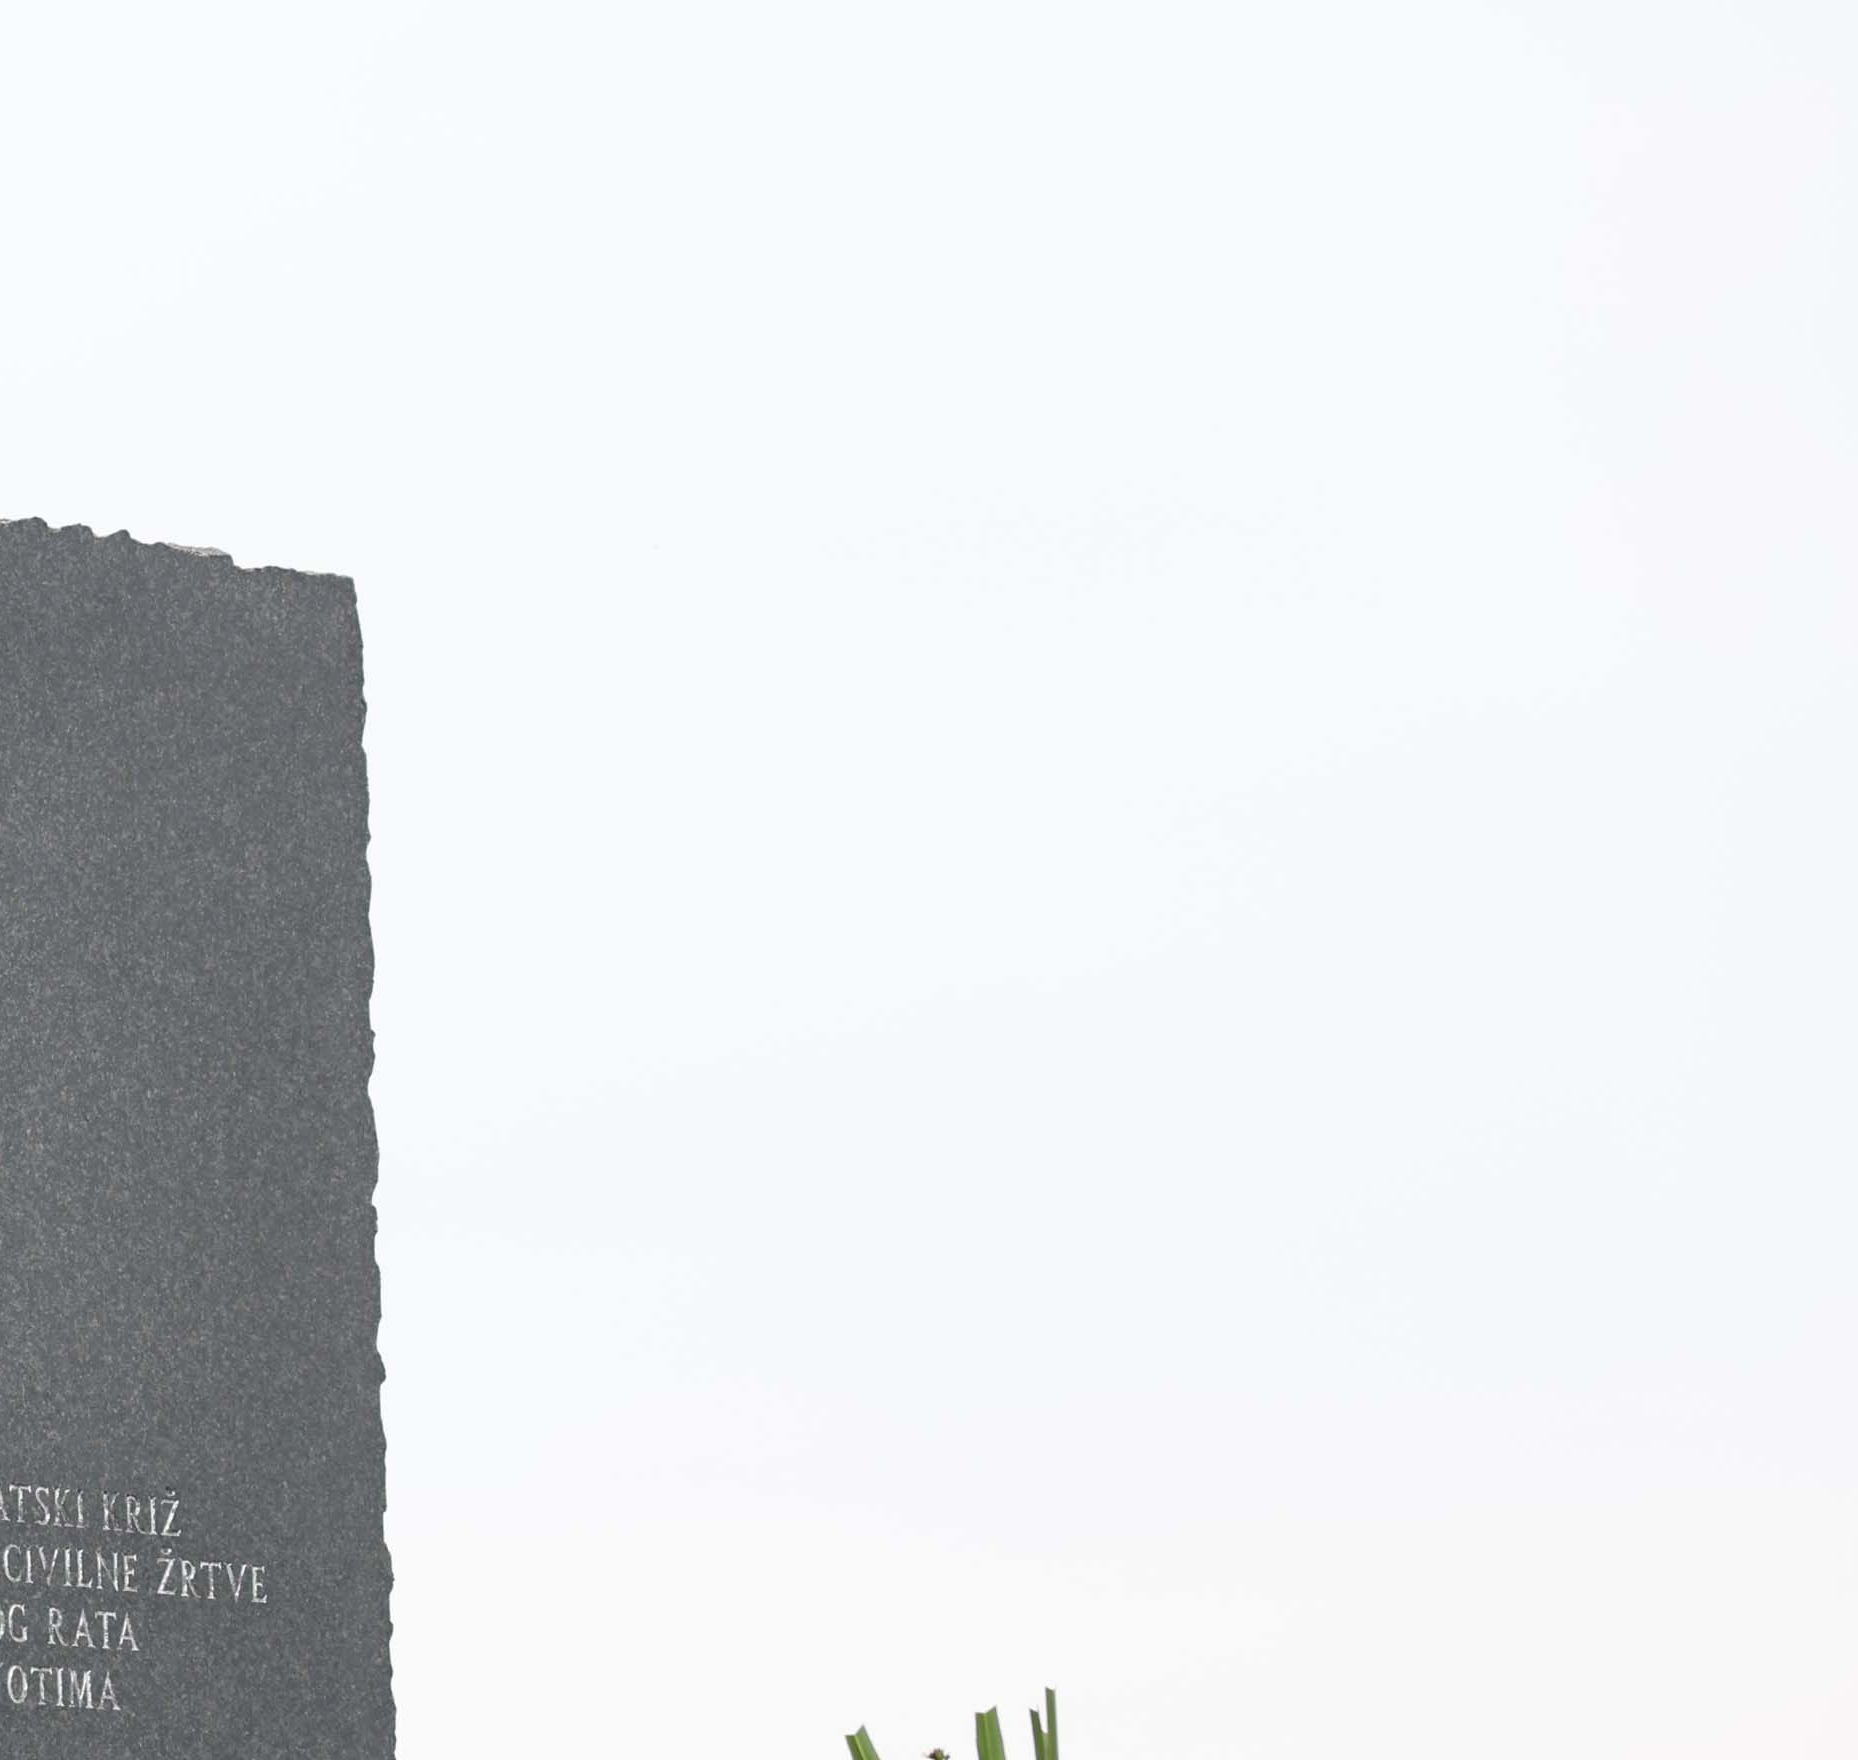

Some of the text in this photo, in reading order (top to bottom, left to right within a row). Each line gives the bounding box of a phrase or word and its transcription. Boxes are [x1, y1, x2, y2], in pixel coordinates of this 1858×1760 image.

[101, 1488, 183, 1538] KRIŽ
[1, 1541, 138, 1594] CIVILNE
[155, 1547, 269, 1605] ŽRTVE
[46, 1605, 141, 1652] RATA
